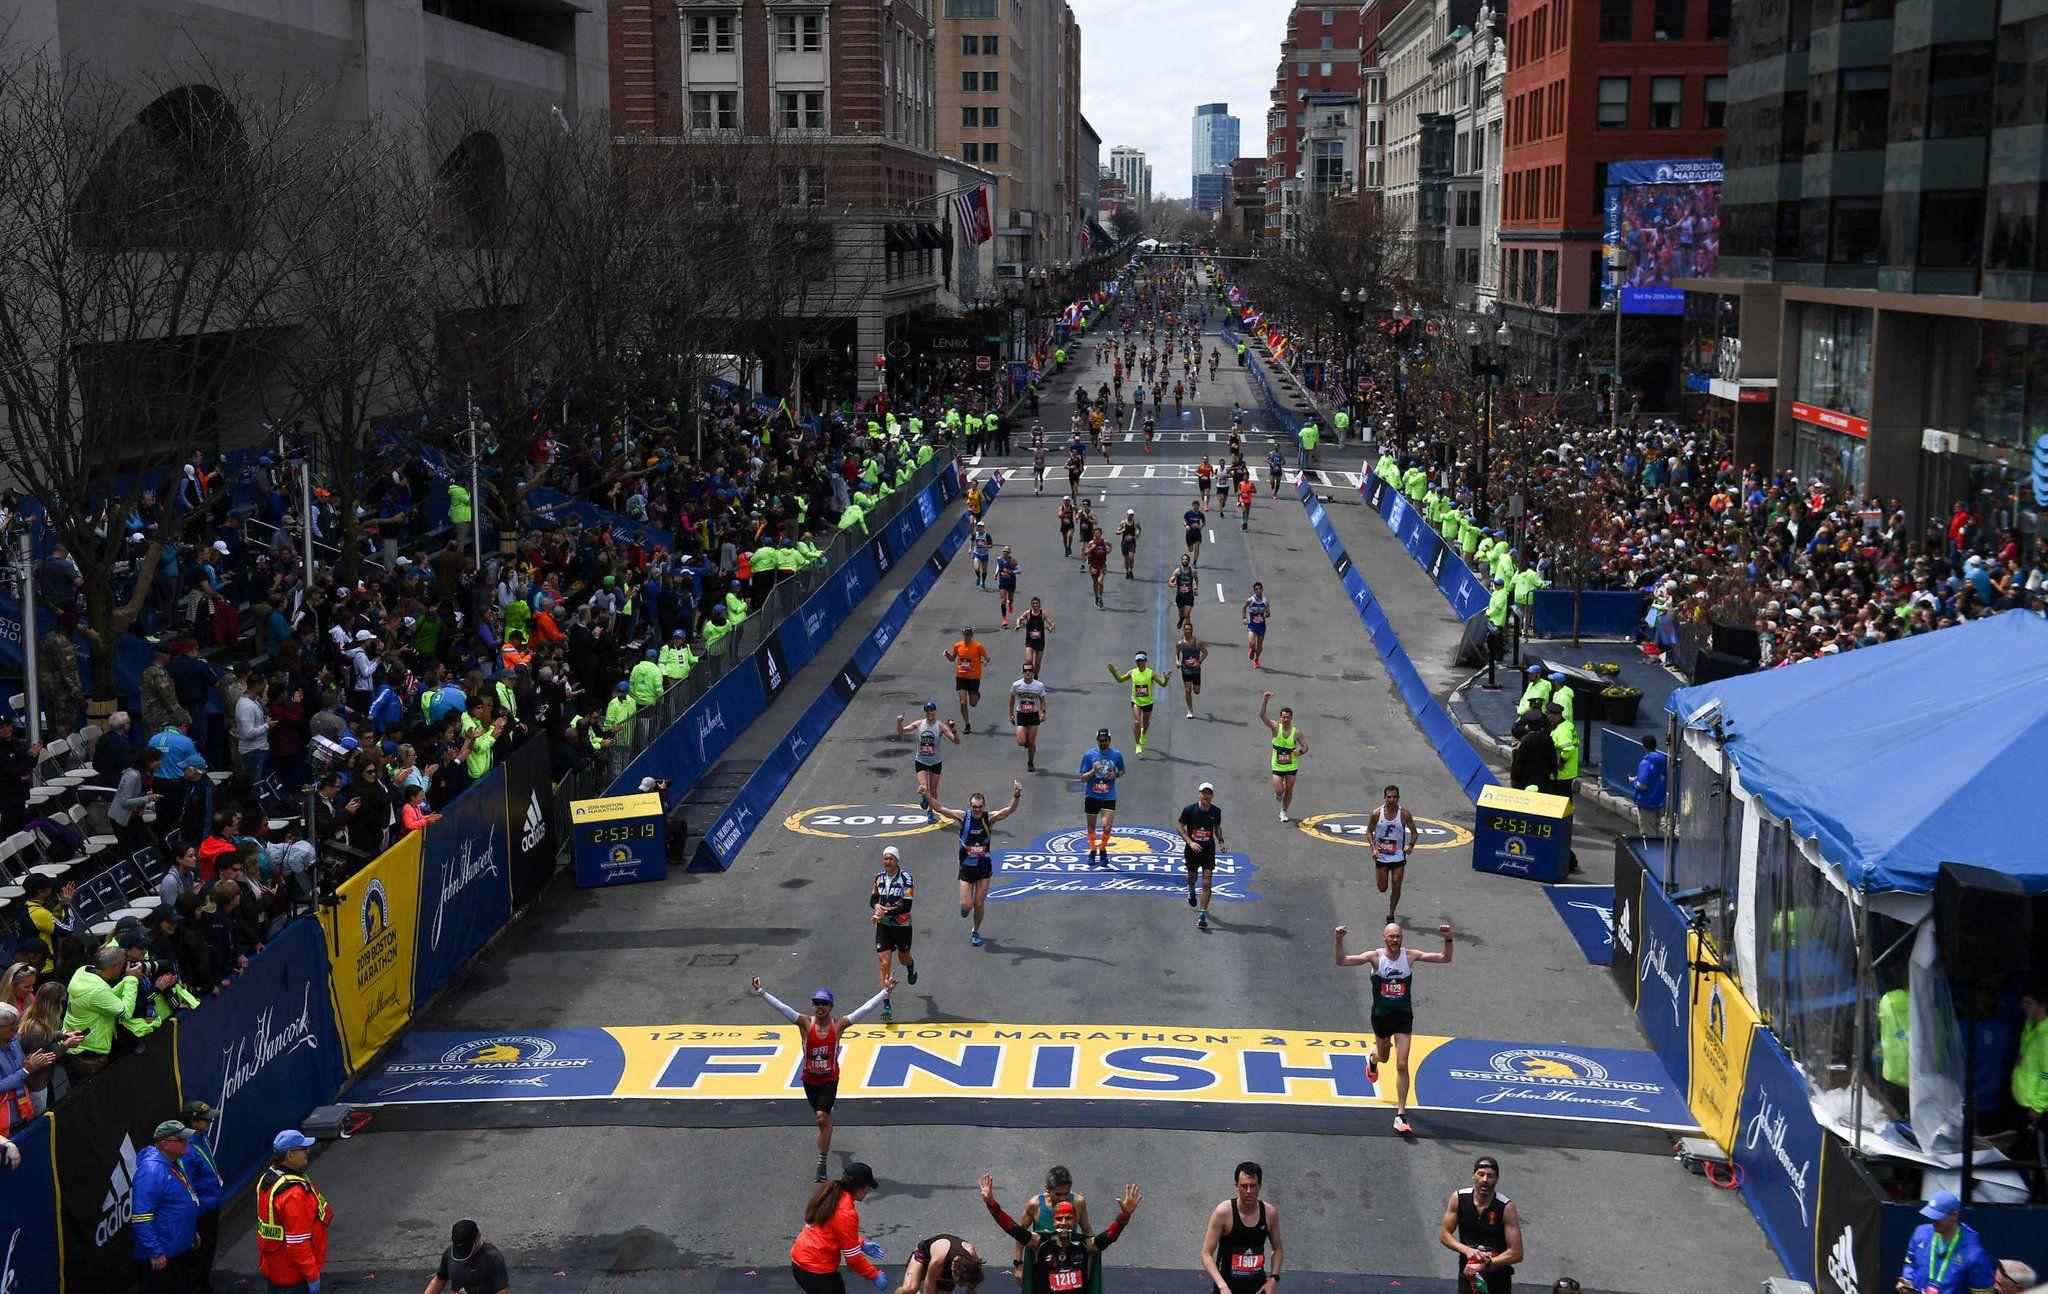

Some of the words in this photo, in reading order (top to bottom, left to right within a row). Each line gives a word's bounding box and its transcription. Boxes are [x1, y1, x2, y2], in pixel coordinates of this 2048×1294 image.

[1673, 171, 1724, 180] MARATHO
[1674, 163, 1691, 172] 2019
[1692, 162, 1723, 171] BOSTO
[932, 337, 970, 349] LENOX
[811, 815, 928, 826] 2019
[1494, 817, 1552, 838] 2:53:19
[521, 821, 547, 853] adidas
[594, 823, 655, 844] 2:53:19
[1384, 824, 1396, 838] F
[1003, 854, 1079, 864] 2019
[1097, 855, 1234, 866] OSTN
[356, 950, 371, 973] 2019
[371, 929, 397, 962] BOSTON
[357, 946, 398, 990] MARATHON
[650, 1031, 742, 1041] 123RD
[839, 1029, 973, 1040] OSTON
[994, 1030, 1229, 1045] MARATHON
[1305, 1038, 1373, 1049] 201
[207, 1036, 250, 1157] John
[249, 980, 318, 1076] Hancock
[386, 1062, 469, 1074] BOSTON
[472, 1058, 590, 1071] MARATHON
[451, 1073, 552, 1088] Hancock
[1449, 1070, 1535, 1084] BOSTON
[1540, 1076, 1661, 1093] MARATHON
[1475, 1086, 1536, 1104] John
[1534, 1088, 1651, 1113] Hancock
[96, 1187, 132, 1247] adid
[1054, 1272, 1077, 1286] 1218
